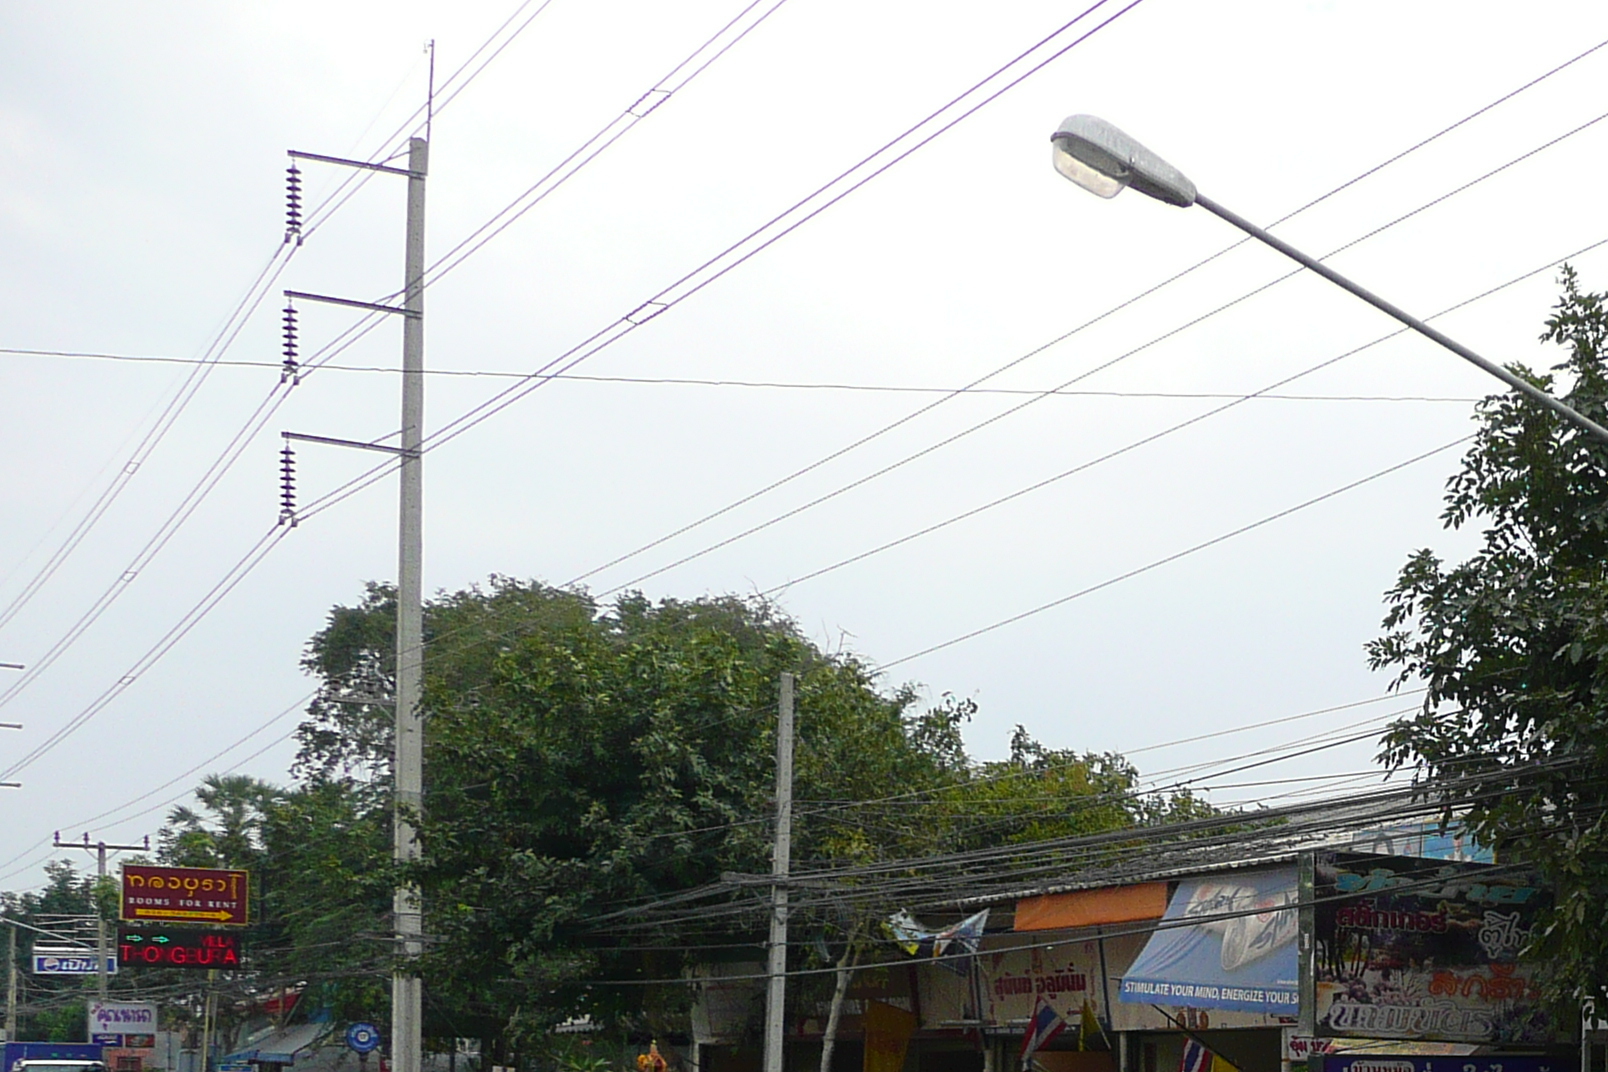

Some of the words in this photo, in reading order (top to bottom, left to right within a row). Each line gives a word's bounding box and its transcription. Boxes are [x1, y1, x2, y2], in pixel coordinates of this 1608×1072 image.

[128, 897, 170, 906] ROOMS
[179, 899, 202, 907] FOR
[207, 901, 237, 909] RENT
[1124, 981, 1169, 995] STIMULATE
[1170, 985, 1194, 996] YOUR
[1194, 986, 1220, 1000] MIND,
[1221, 988, 1264, 1003] ENERGIZE
[1265, 991, 1290, 1004] YOUR
